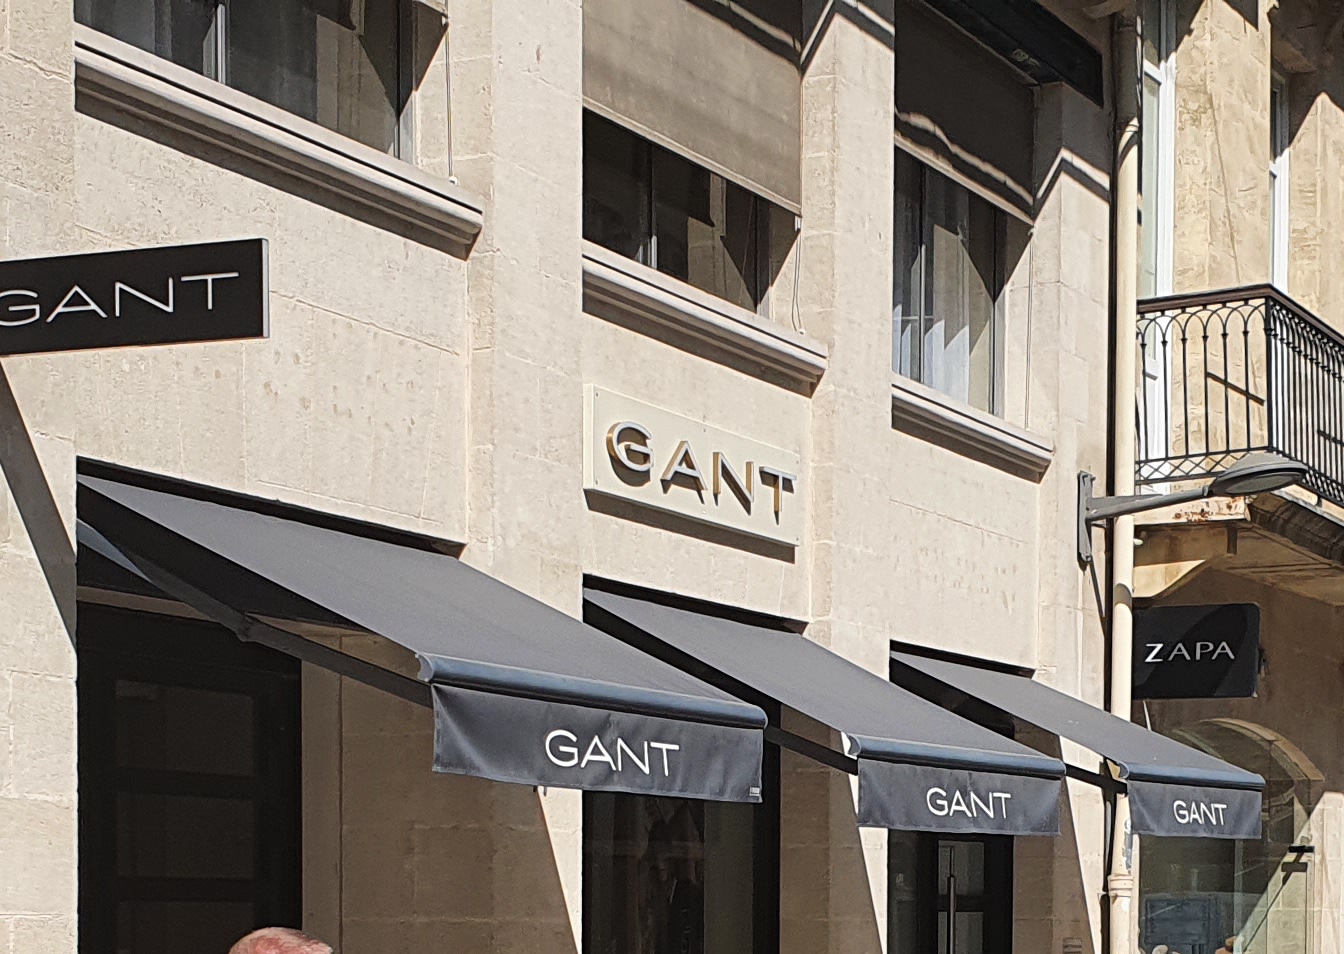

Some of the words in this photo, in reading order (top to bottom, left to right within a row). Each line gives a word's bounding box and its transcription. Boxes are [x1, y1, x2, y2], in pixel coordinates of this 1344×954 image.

[606, 420, 798, 523] GANT
[1144, 640, 1236, 664] ZAPA
[543, 728, 681, 779] GANT
[925, 786, 1012, 822] GANT
[1172, 799, 1228, 829] GANT
